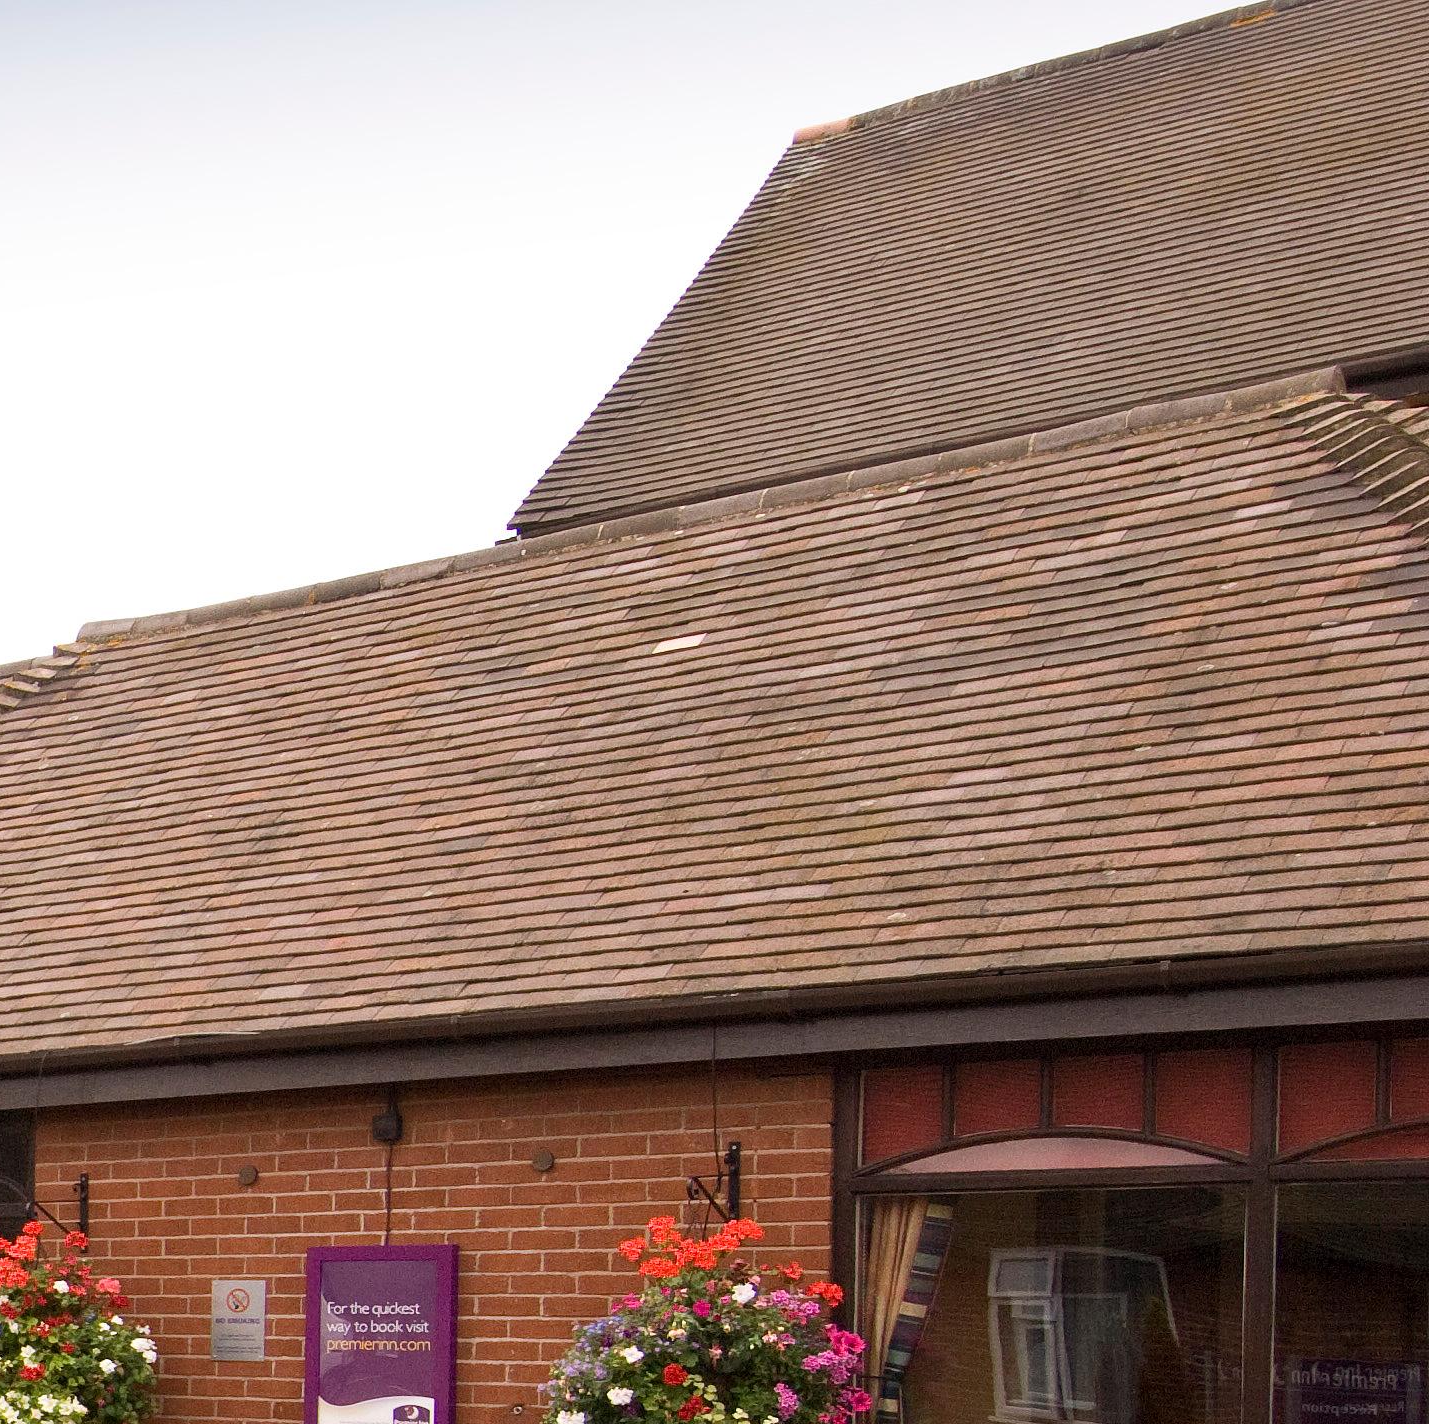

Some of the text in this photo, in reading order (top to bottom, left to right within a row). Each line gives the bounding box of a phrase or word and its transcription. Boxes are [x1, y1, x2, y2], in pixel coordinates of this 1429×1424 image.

[327, 1301, 420, 1318] For the quickest
[326, 1320, 429, 1336] way to book visit
[326, 1338, 431, 1354] premierinn.com
